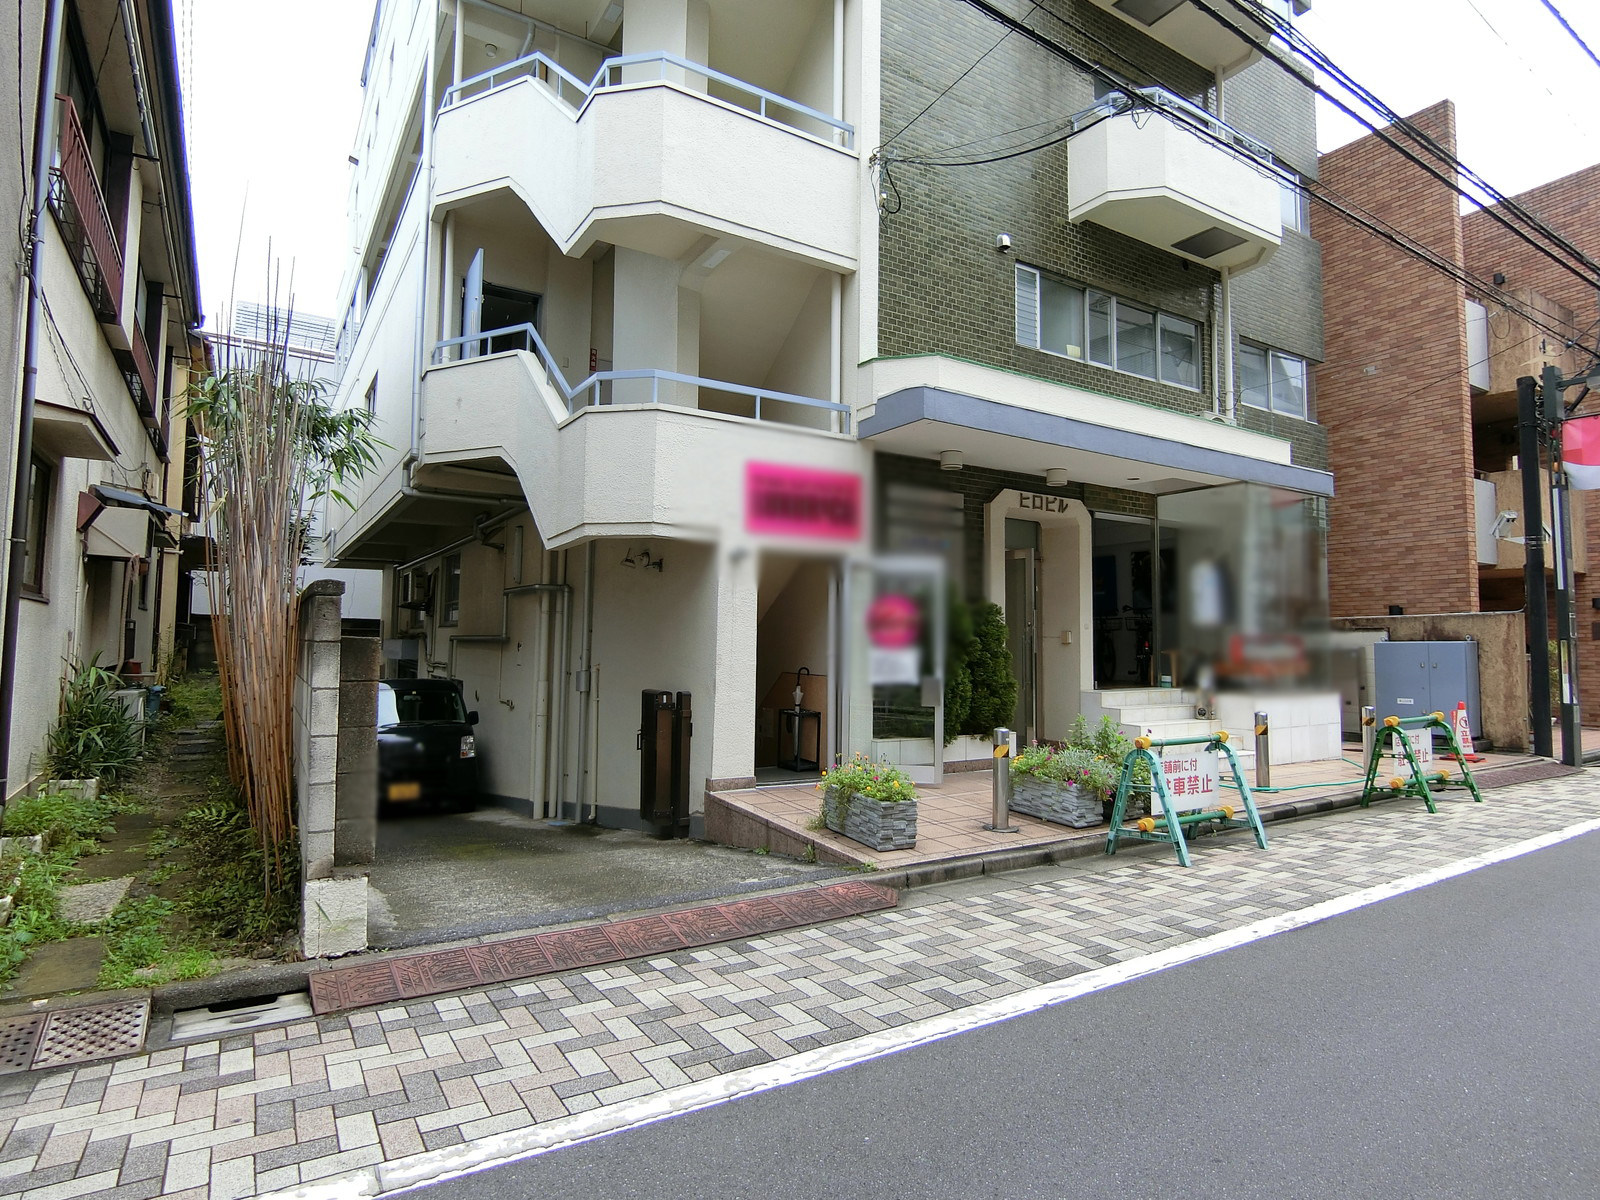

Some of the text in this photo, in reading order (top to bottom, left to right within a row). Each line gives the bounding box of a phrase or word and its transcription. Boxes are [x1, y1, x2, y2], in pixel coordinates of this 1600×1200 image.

[1019, 492, 1069, 514] ヒロビル
[1160, 757, 1198, 775] 舗前に付
